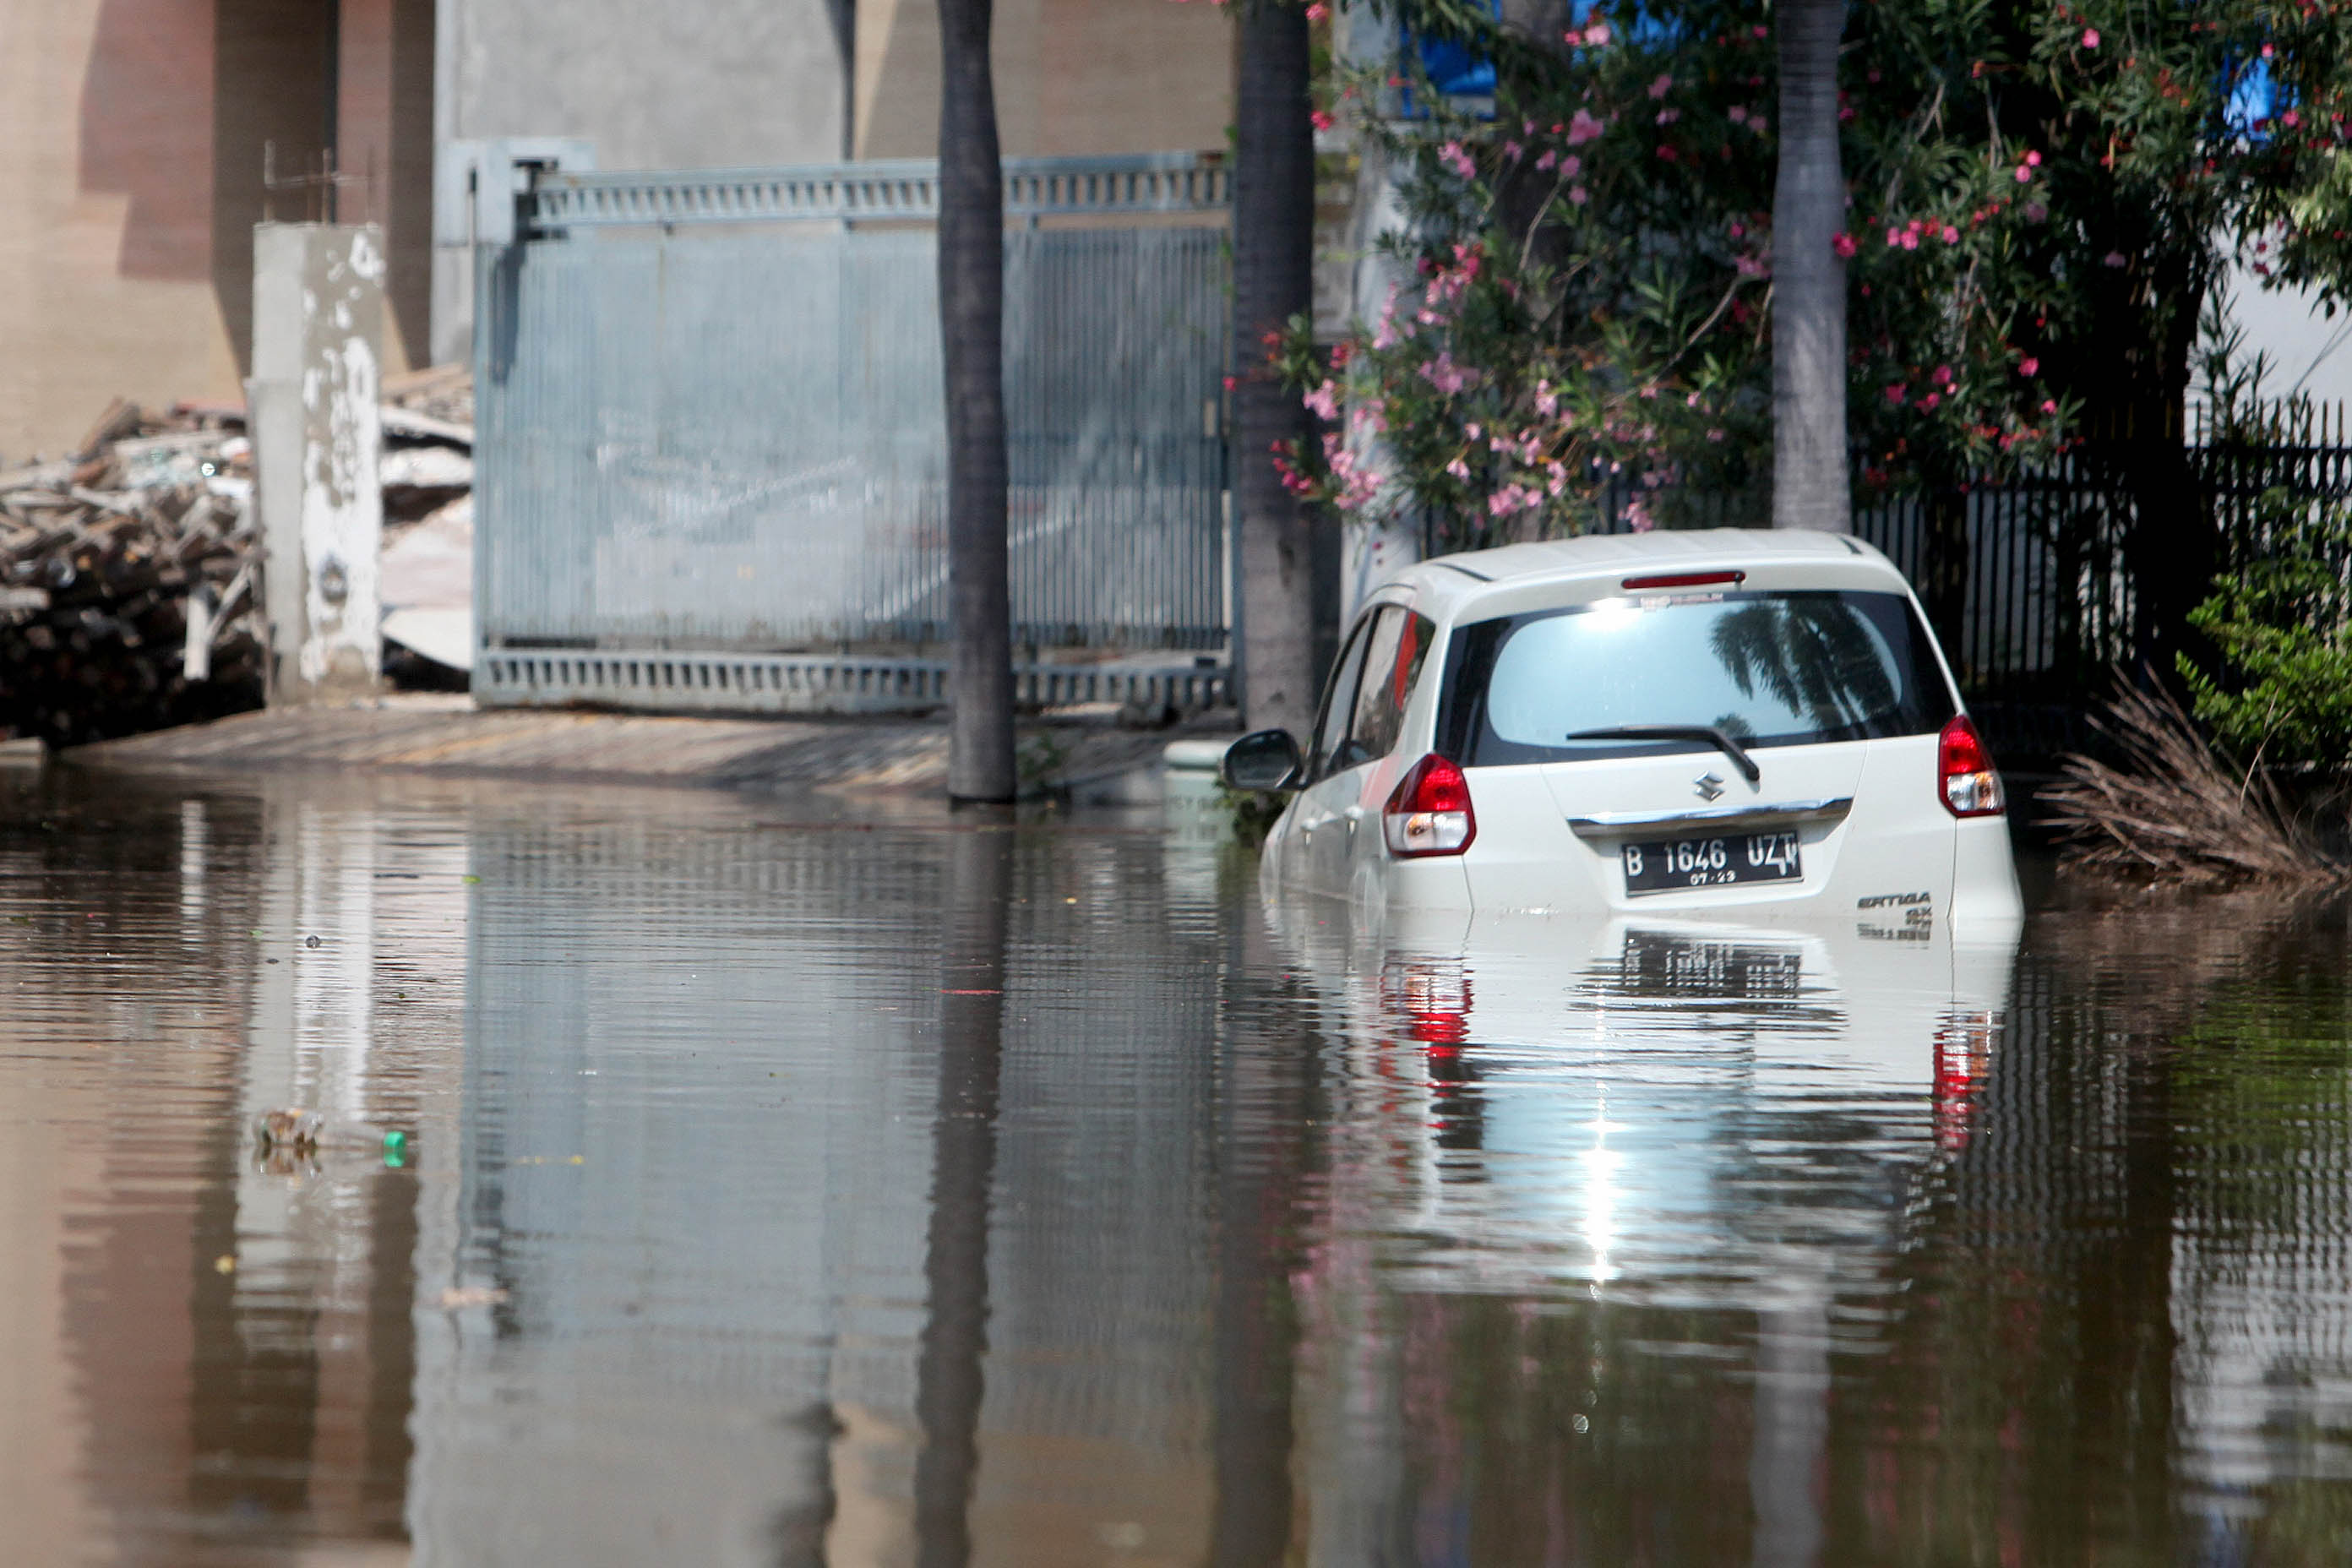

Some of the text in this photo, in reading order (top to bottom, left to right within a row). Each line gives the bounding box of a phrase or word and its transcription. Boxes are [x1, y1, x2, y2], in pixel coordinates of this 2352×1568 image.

[1625, 846, 1644, 876] B
[1664, 839, 1727, 874] 1646
[1857, 891, 1930, 908] ERTIGA
